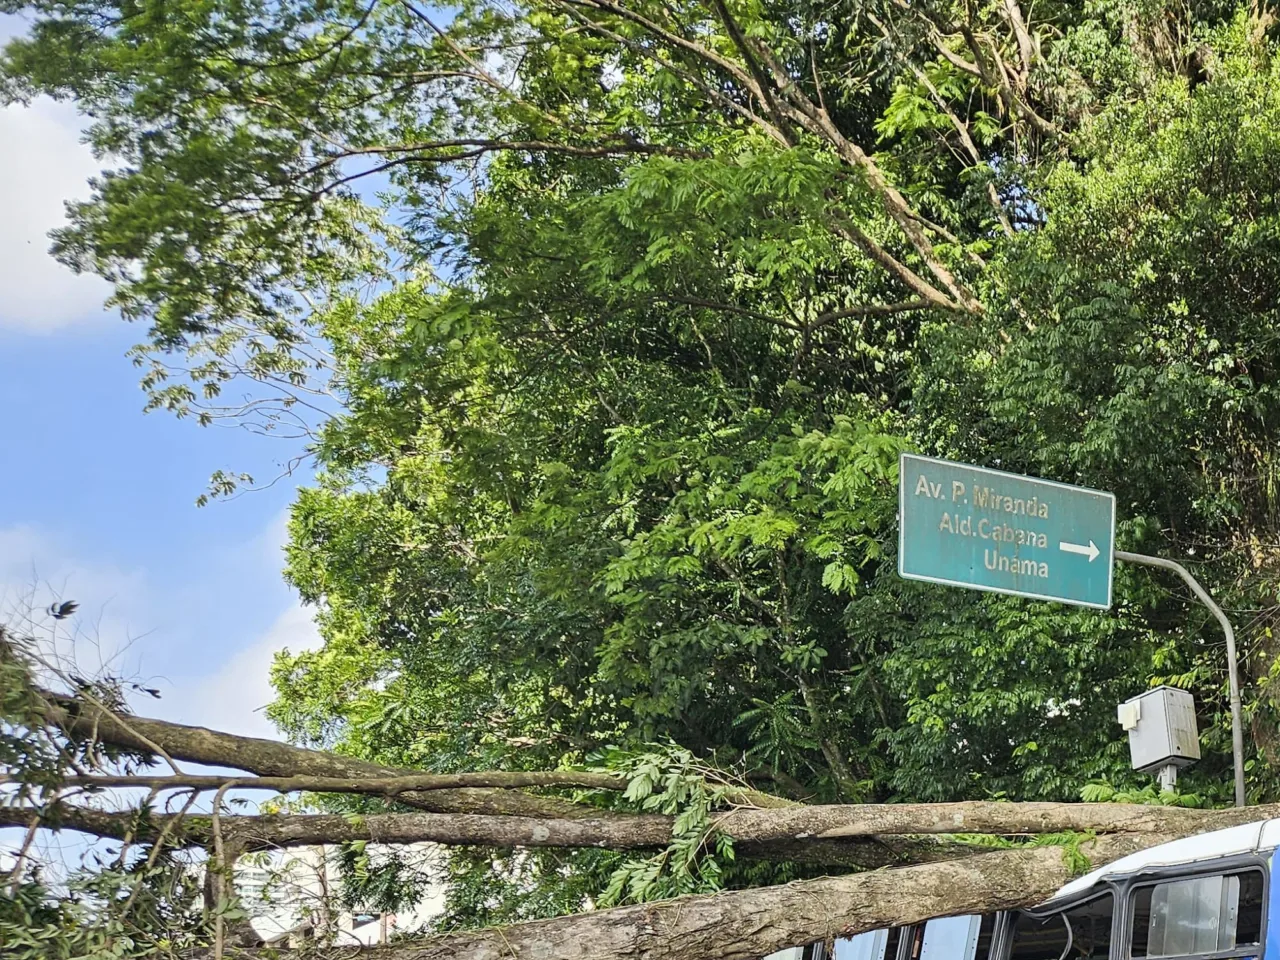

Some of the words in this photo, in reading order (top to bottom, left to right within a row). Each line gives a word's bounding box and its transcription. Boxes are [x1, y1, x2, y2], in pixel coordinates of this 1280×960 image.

[915, 474, 946, 500] Av.
[952, 480, 968, 504] P.
[973, 485, 1049, 519] Miranda
[984, 548, 1049, 578] Unama
